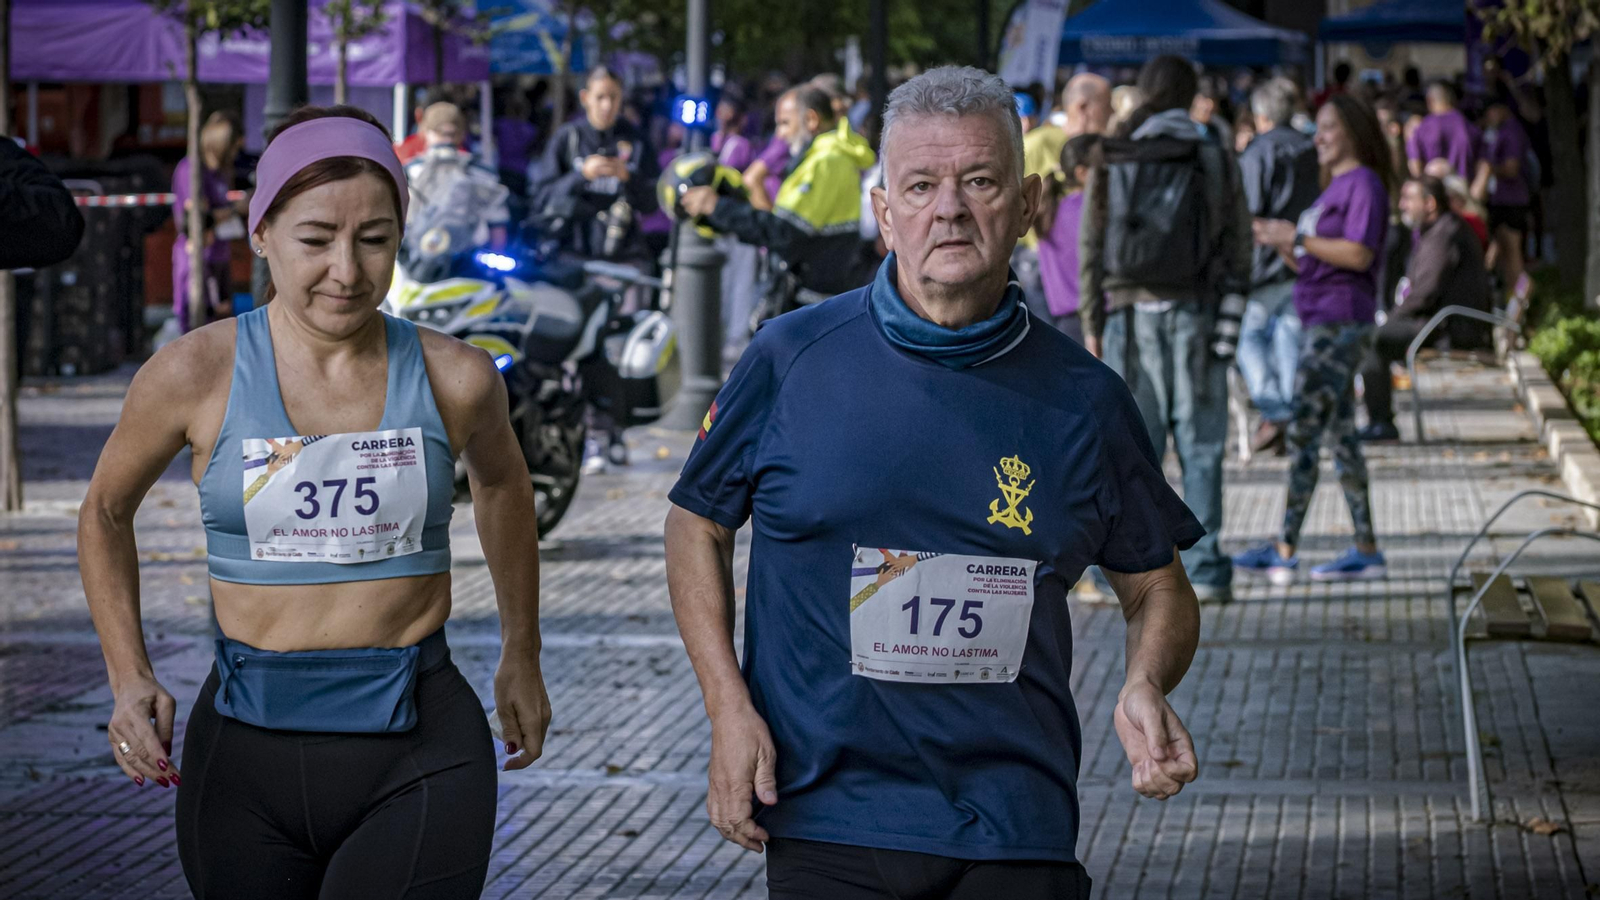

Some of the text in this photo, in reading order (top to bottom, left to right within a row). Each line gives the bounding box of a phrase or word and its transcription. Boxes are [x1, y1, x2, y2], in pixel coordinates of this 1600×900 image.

[352, 436, 415, 451] CARRERA
[294, 476, 380, 520] 375
[273, 522, 400, 538] EL AMOR NO LASTIMA
[966, 563, 1027, 577] CARRERA
[902, 595, 984, 639] 175
[873, 642, 999, 658] EL AMOR NO LASTIMA
